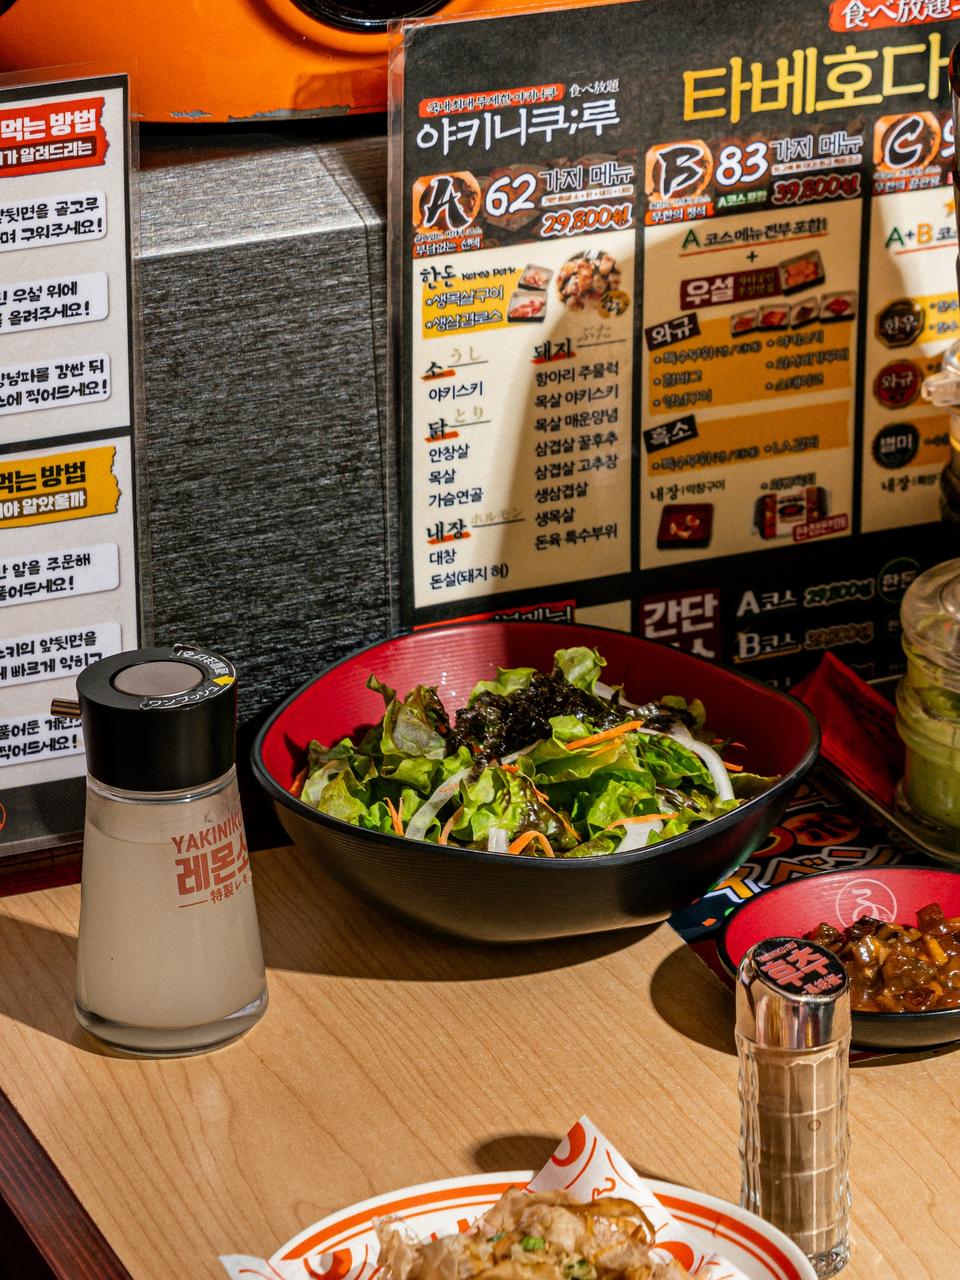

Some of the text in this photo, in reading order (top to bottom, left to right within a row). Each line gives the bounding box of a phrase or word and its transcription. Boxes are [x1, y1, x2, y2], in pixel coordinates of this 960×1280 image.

[569, 78, 620, 99] 食べ放題
[682, 31, 952, 125] 타베호다
[1, 109, 97, 141] 먹는 방법
[416, 98, 621, 157] 야키니쿠;루
[20, 141, 93, 164] 알려드리는
[769, 129, 865, 162] 가지 메뉴
[538, 160, 635, 194] 가지 메뉴
[656, 143, 706, 198] B
[714, 141, 770, 187] 83
[54, 197, 100, 218] 골고루
[423, 175, 471, 230] A
[485, 172, 538, 217] 62
[20, 217, 103, 242] 구워주세요!
[540, 202, 633, 238] 29,800원
[681, 228, 701, 250] A
[419, 264, 457, 291] 한돈
[685, 275, 735, 306] 우설
[12, 280, 78, 303] 우설 위에
[8, 300, 90, 326] 올려주세요!
[650, 317, 694, 345] 와규
[533, 337, 574, 361] 돼지
[535, 360, 620, 388] 항아리 주물럭
[25, 379, 108, 405] 찍어드세요!
[428, 381, 484, 403] 야키스키
[534, 384, 619, 411] 목살 야키스키
[534, 407, 619, 433] 목살 매운양념
[428, 443, 470, 463] 안창살
[534, 430, 619, 458] 삼겹살 꿀후추
[40, 462, 86, 489] 방법
[427, 468, 456, 486] 목살
[534, 453, 619, 481] 삼겹살 고추장
[428, 486, 485, 510] 가슴연골
[534, 480, 590, 505] 생삼겹살
[425, 518, 469, 543] 내장
[534, 507, 576, 528] 생목살
[534, 522, 619, 552] 돈육 특수부위
[46, 552, 92, 572] 주문해
[429, 548, 457, 566] 대창
[429, 565, 488, 591] 돈설(돼지
[642, 591, 720, 640] 간단
[39, 631, 98, 654] 앞뒷면을
[10, 657, 57, 678] 빠르게
[759, 945, 831, 988] 후추
